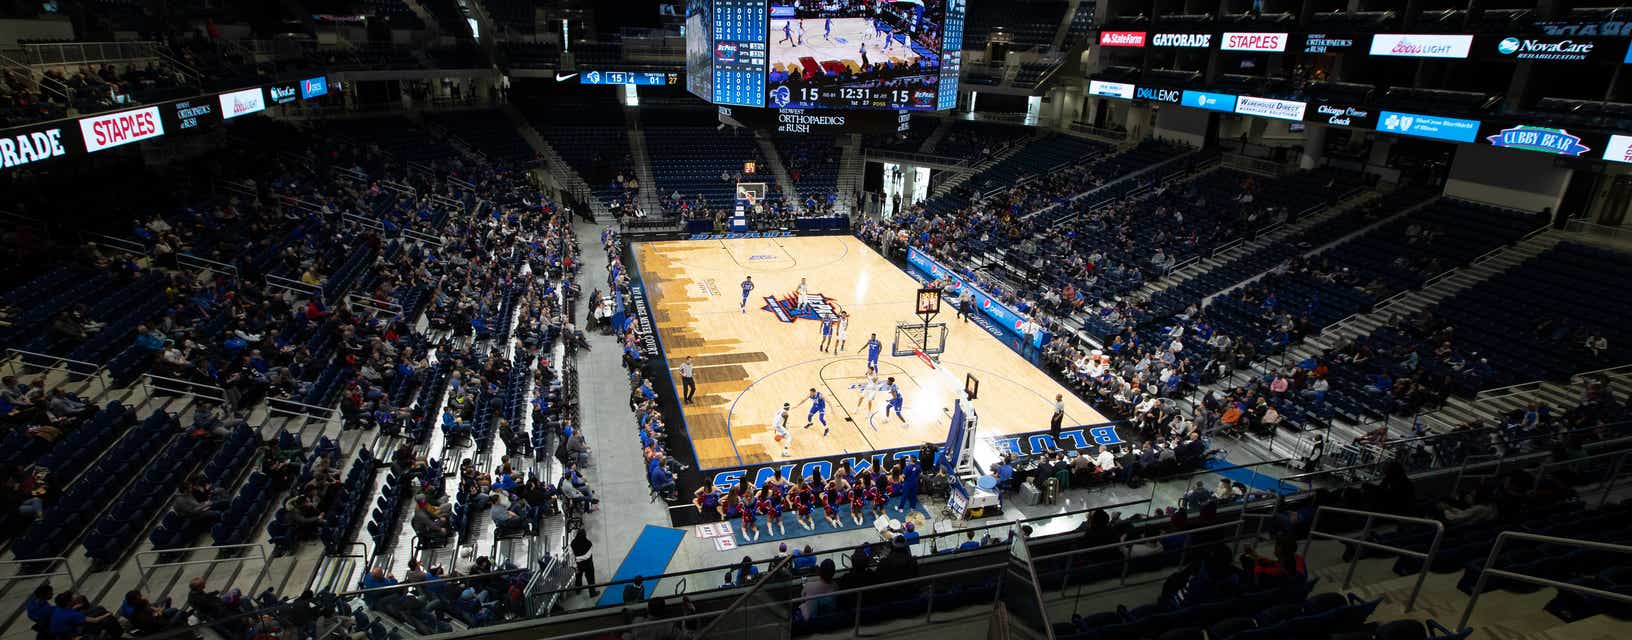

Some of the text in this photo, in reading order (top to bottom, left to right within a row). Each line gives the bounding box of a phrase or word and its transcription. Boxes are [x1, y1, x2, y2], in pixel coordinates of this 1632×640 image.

[1153, 33, 1211, 47] GATORADE
[1228, 36, 1279, 49] STAPLES
[1519, 39, 1594, 53] NovaCare
[1422, 45, 1451, 54] LIGHT
[611, 74, 623, 82] 15
[801, 88, 818, 101] 15
[840, 88, 870, 99] 12:31
[892, 90, 909, 102] 15
[1137, 87, 1158, 100] DELL
[1158, 89, 1179, 103] EMC
[779, 114, 845, 126] ORTHOPAEDICS
[93, 112, 156, 146] STAPLES
[786, 124, 809, 133] RUSH
[1504, 130, 1573, 151] CUBBY BEAR
[645, 335, 658, 355] COURT
[713, 426, 1126, 493] BLUE MONS
